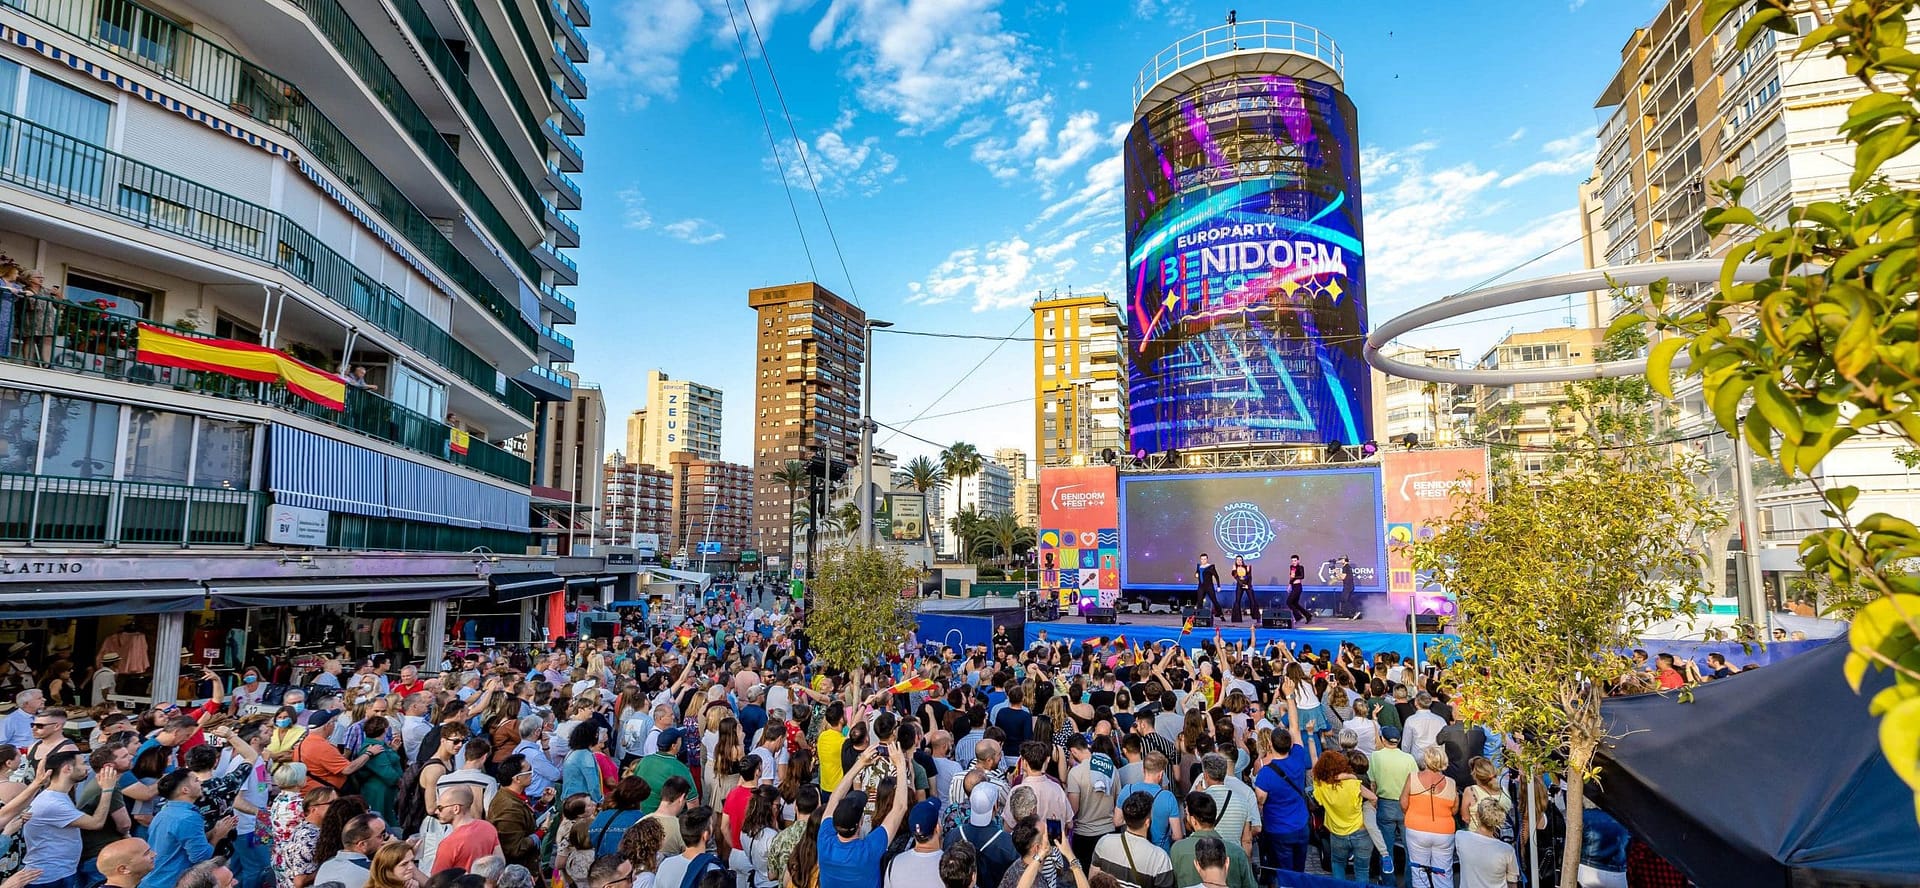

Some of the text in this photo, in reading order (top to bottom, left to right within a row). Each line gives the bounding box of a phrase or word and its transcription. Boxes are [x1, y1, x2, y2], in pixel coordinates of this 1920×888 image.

[1178, 222, 1277, 249] EUROPARTY
[1160, 239, 1343, 286] BENIDORM
[667, 395, 677, 442] ZEUS
[1061, 492, 1105, 501] BENIDORM
[1421, 489, 1447, 497] FEST
[1066, 499, 1087, 507] FEST
[1224, 502, 1259, 512] MARTA
[280, 523, 290, 533] BV
[3, 561, 82, 574] LATINO
